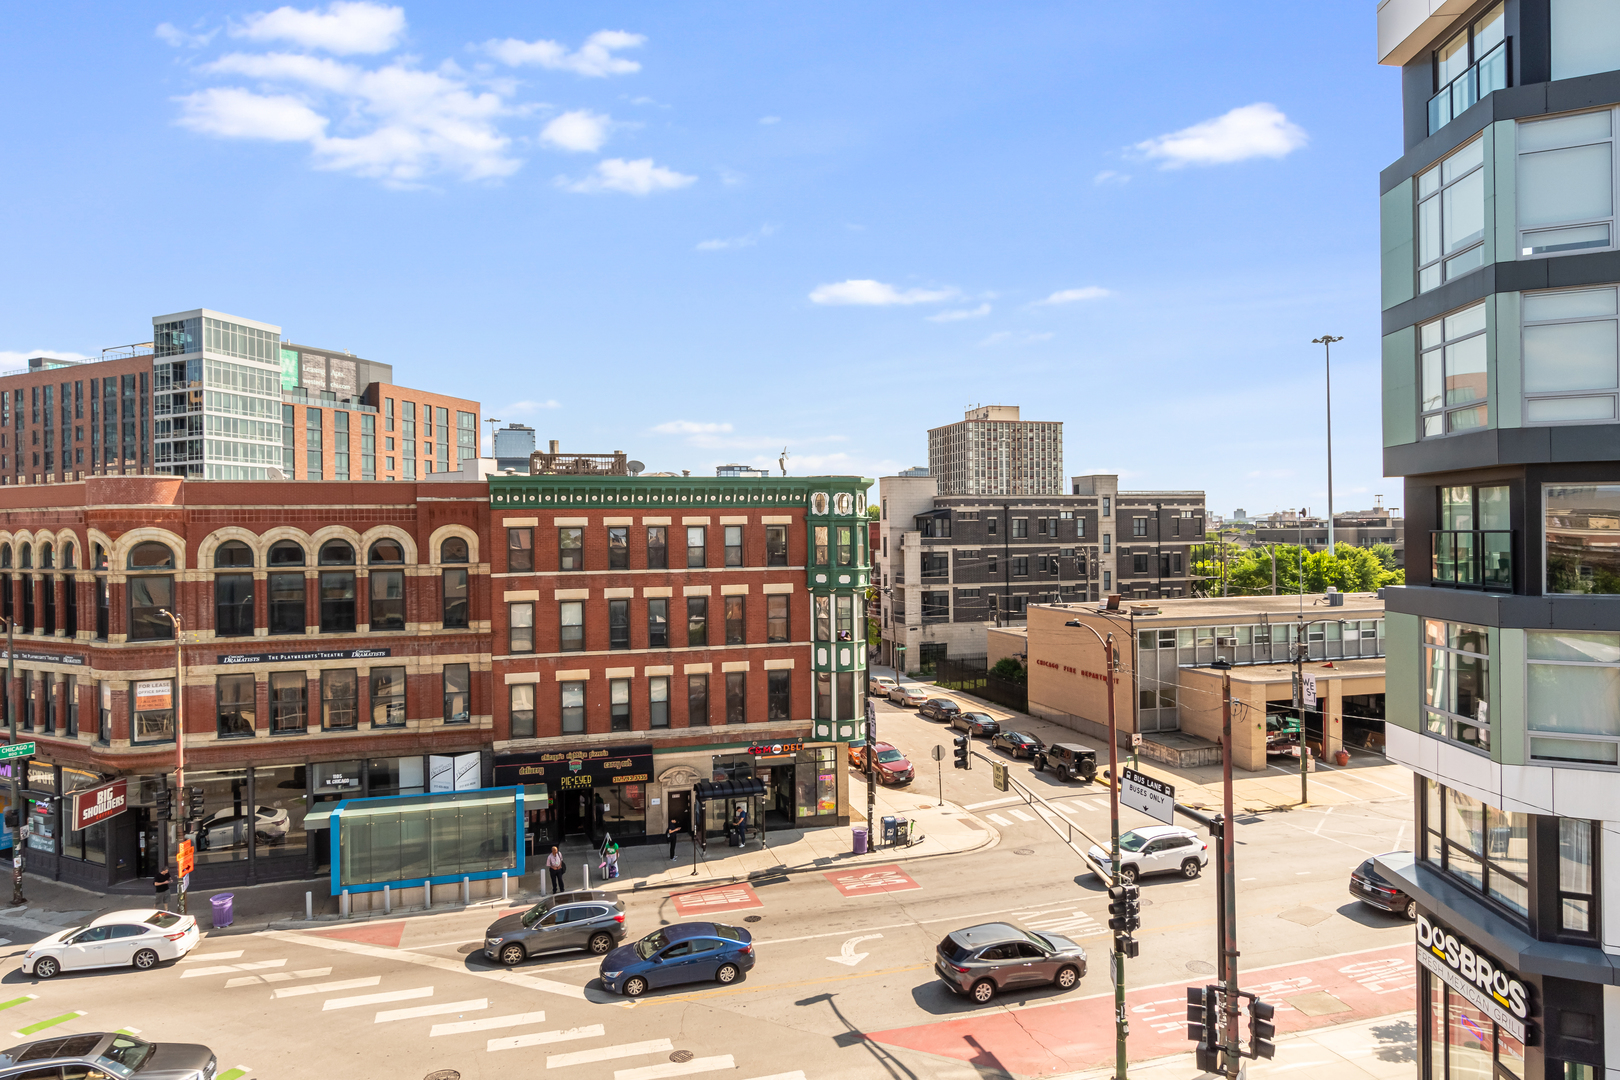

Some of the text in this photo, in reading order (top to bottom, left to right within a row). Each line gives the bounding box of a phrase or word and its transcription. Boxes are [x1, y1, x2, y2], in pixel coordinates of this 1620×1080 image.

[1036, 660, 1119, 684] CHICAGO FIRE DEPARTMT
[2, 744, 28, 754] CHICAGO
[748, 743, 804, 754] C&M DELI
[519, 766, 544, 776] delivery
[1133, 774, 1162, 792] BUS LANE
[97, 787, 114, 805] BIG
[1129, 784, 1165, 804] BUSES ONLY
[82, 794, 124, 820] SHOULDERS
[1418, 948, 1443, 975] FRESH
[1447, 970, 1489, 1013] MEXICAN
[1494, 1007, 1524, 1040] GRILL
